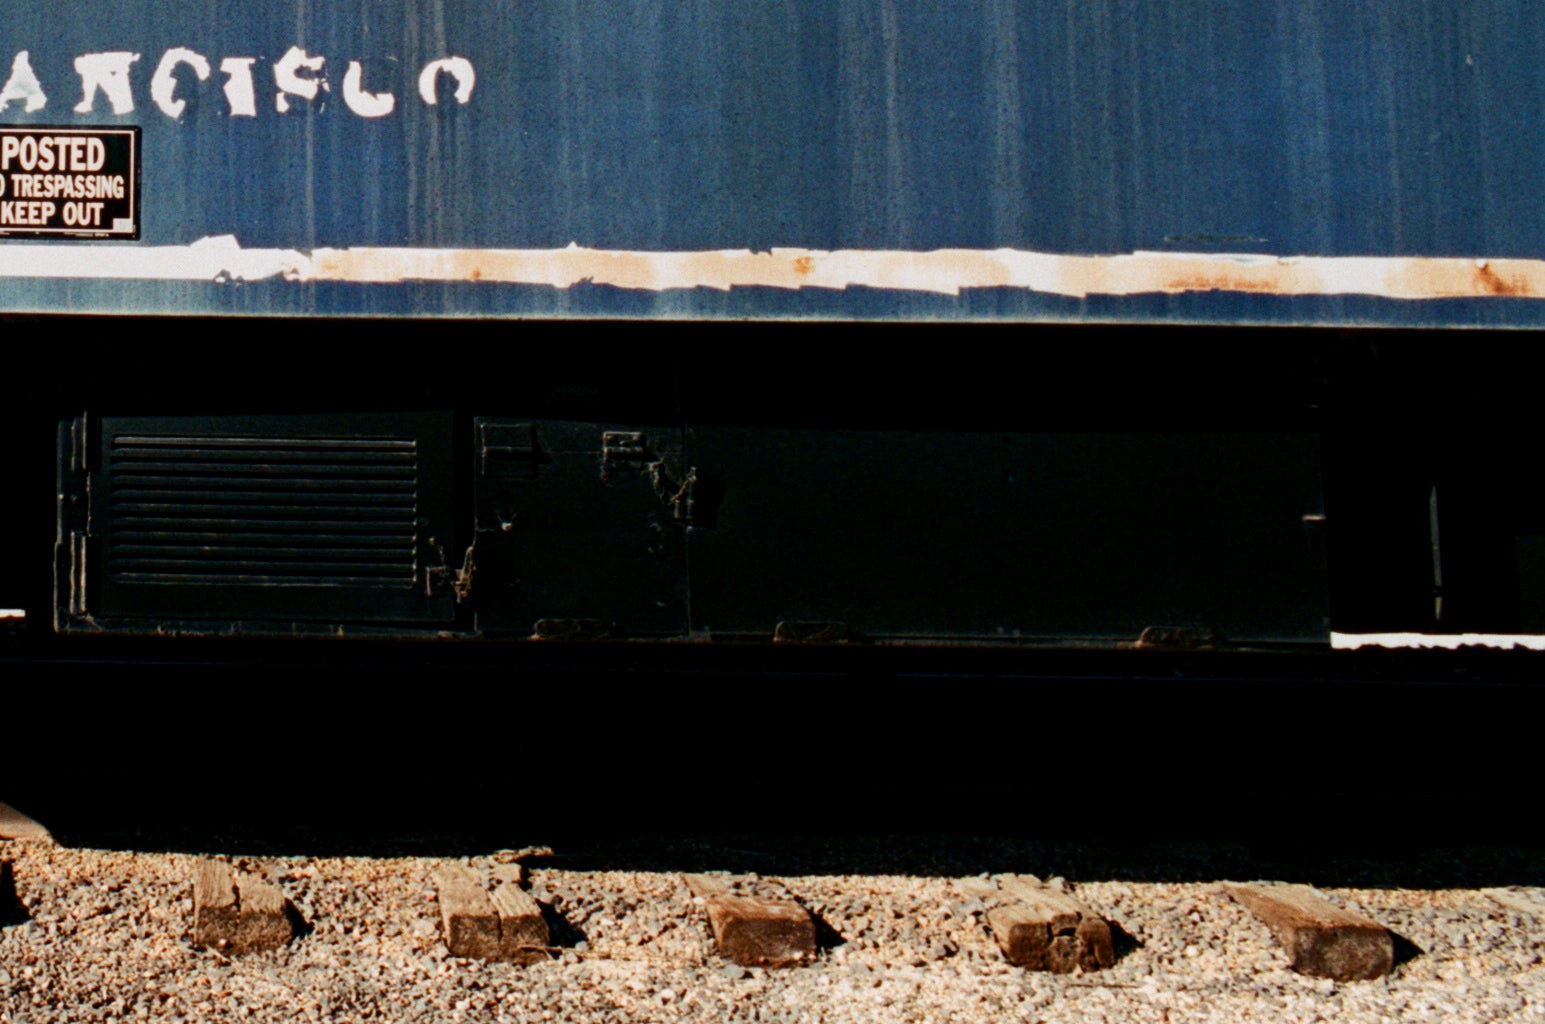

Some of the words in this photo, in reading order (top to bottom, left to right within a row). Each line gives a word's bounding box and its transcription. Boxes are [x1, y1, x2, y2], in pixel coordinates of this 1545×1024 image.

[1, 135, 105, 172] POSTED
[11, 173, 125, 199] TRESPASSING
[0, 200, 56, 225] KEEP
[62, 201, 105, 226] OUT
